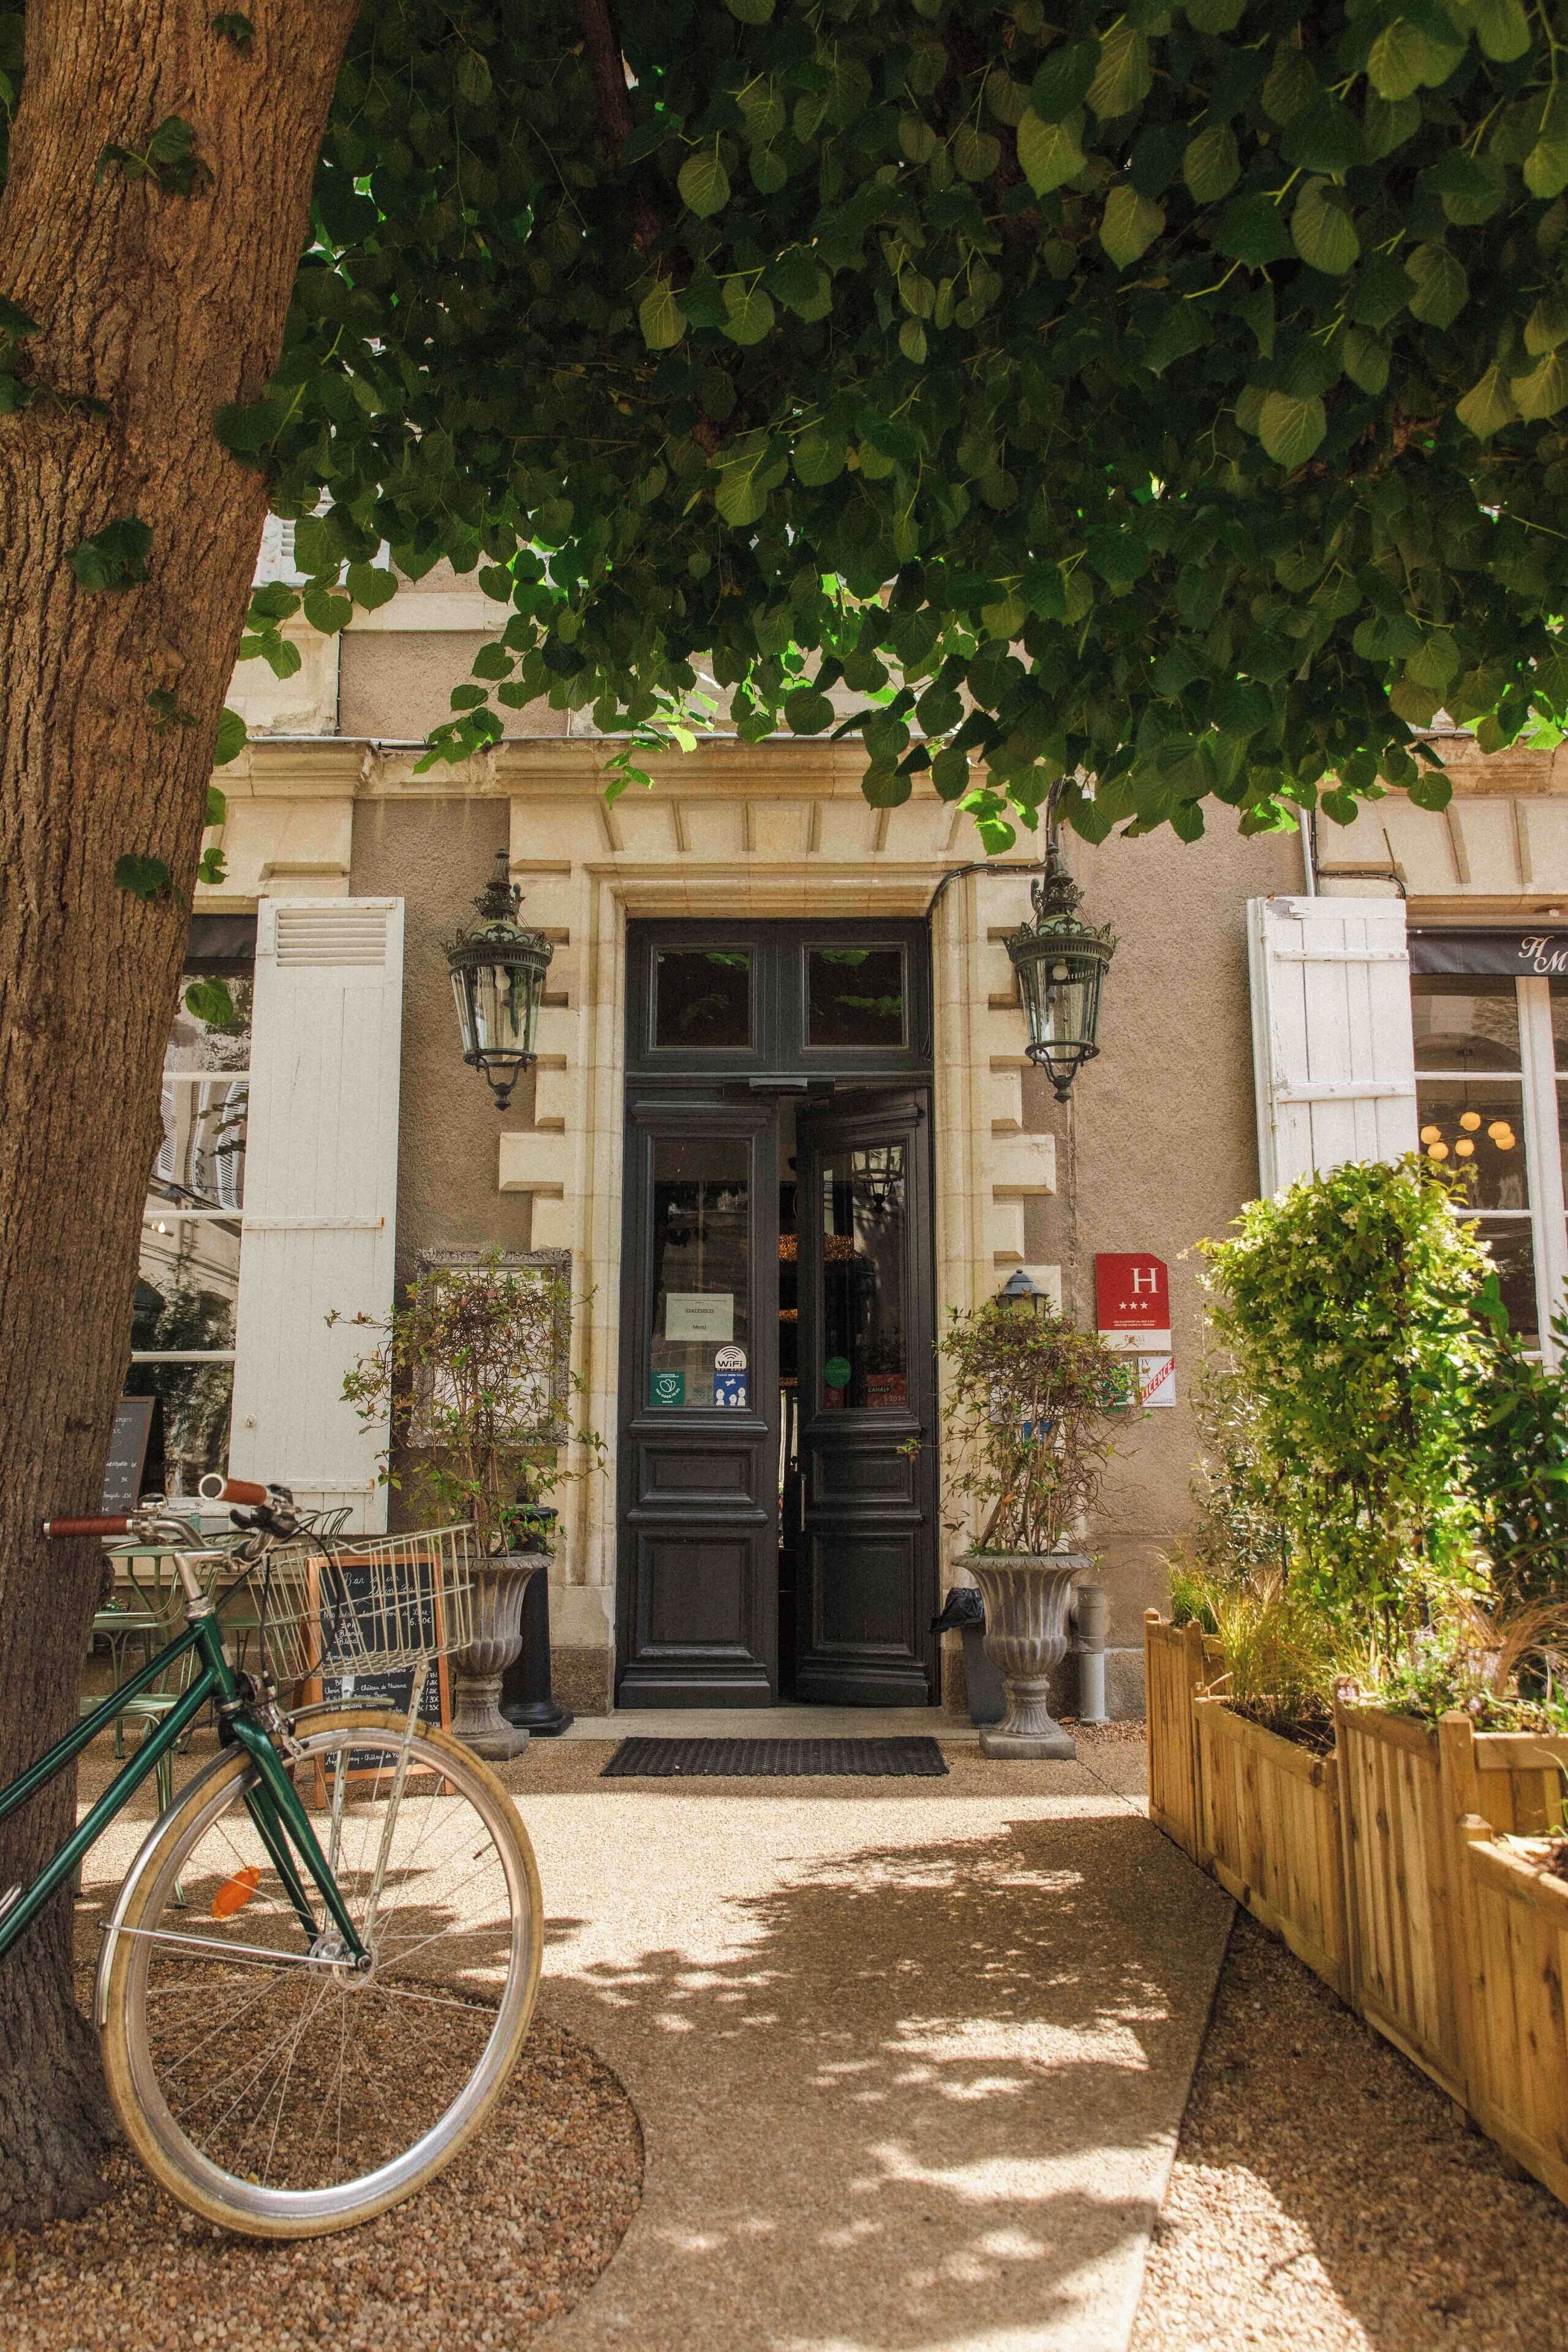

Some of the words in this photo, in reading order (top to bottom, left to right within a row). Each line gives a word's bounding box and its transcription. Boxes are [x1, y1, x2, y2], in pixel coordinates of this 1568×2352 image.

[1130, 1268, 1159, 1294] H
[1142, 1360, 1172, 1402] LICENCE
[343, 1572, 365, 1587] Bar
